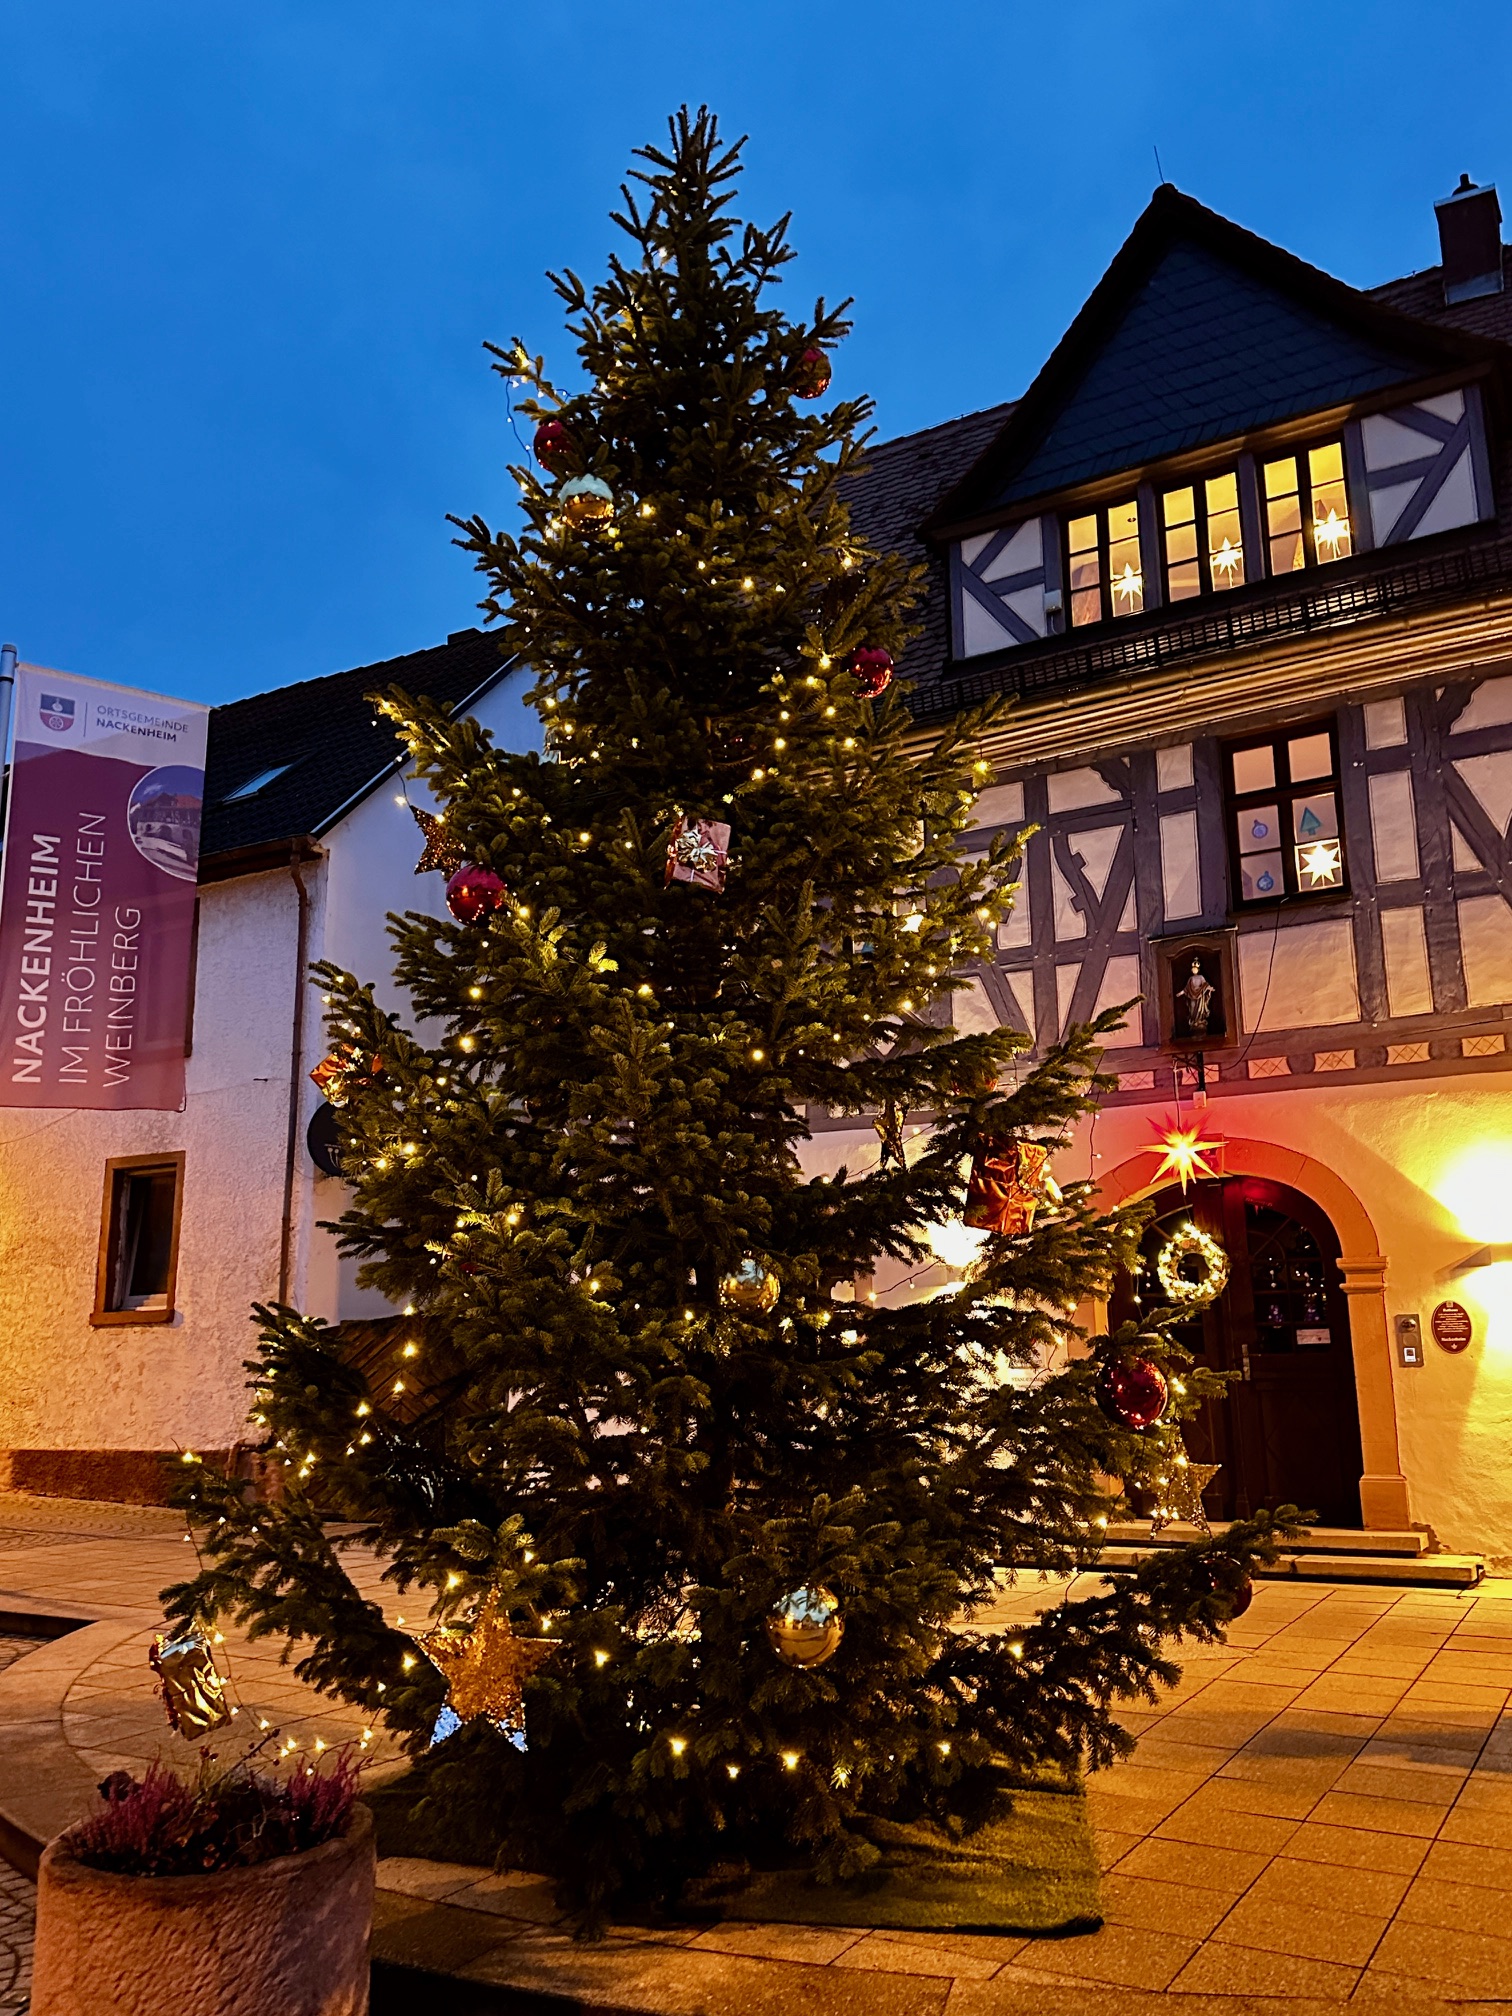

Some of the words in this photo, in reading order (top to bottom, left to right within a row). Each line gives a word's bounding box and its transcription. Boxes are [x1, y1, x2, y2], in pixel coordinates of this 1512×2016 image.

[96, 718, 177, 742] NACKENHEIM
[97, 705, 189, 733] ORTSGEMEINDE
[12, 833, 61, 1083] NACKENHEIM
[61, 812, 106, 1032] FRÖHLICHEN
[103, 906, 141, 1087] WEINBERG
[58, 1046, 90, 1083] IM
